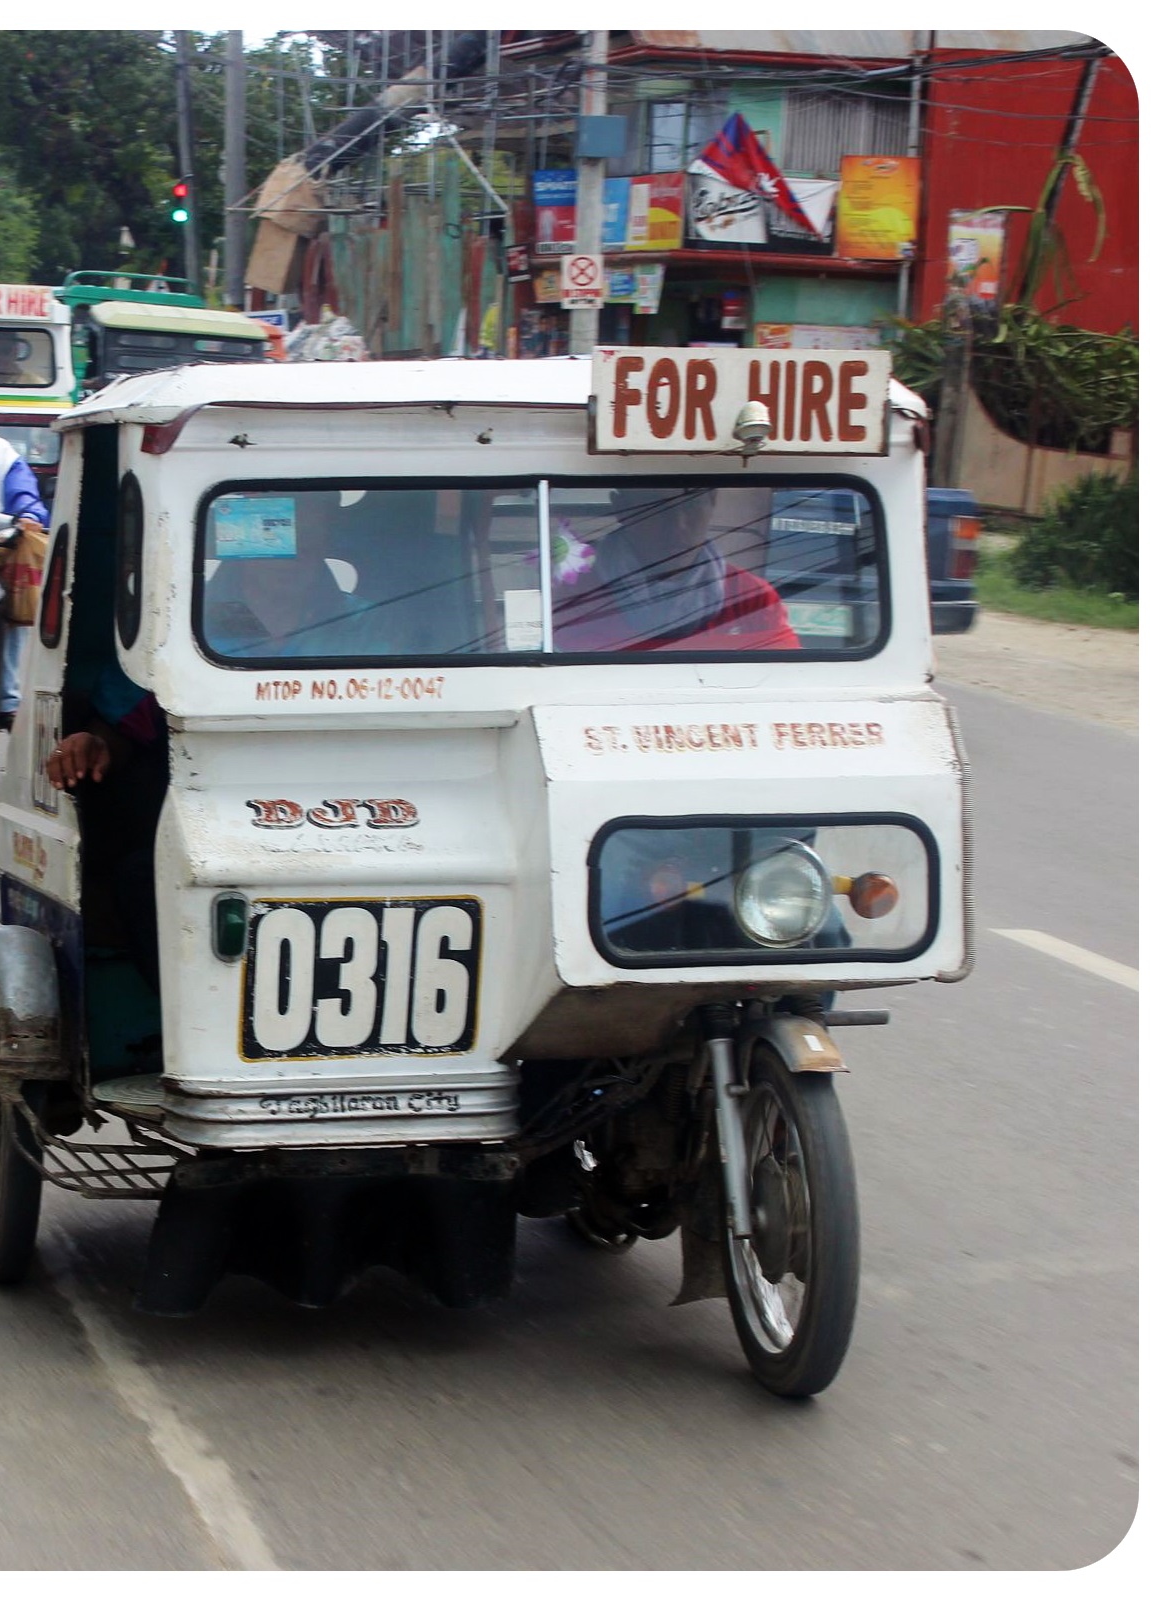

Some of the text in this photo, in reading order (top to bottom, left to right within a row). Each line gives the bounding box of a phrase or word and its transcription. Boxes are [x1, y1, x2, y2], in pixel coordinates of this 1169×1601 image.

[8, 289, 49, 316] HIRE
[613, 356, 869, 441] FOR HIRE
[256, 680, 302, 701] MTOP
[583, 725, 629, 755] ST.
[772, 721, 884, 750] FERRER
[245, 799, 420, 829] DJD
[253, 906, 473, 1051] 0316
[408, 1092, 461, 1113] City
